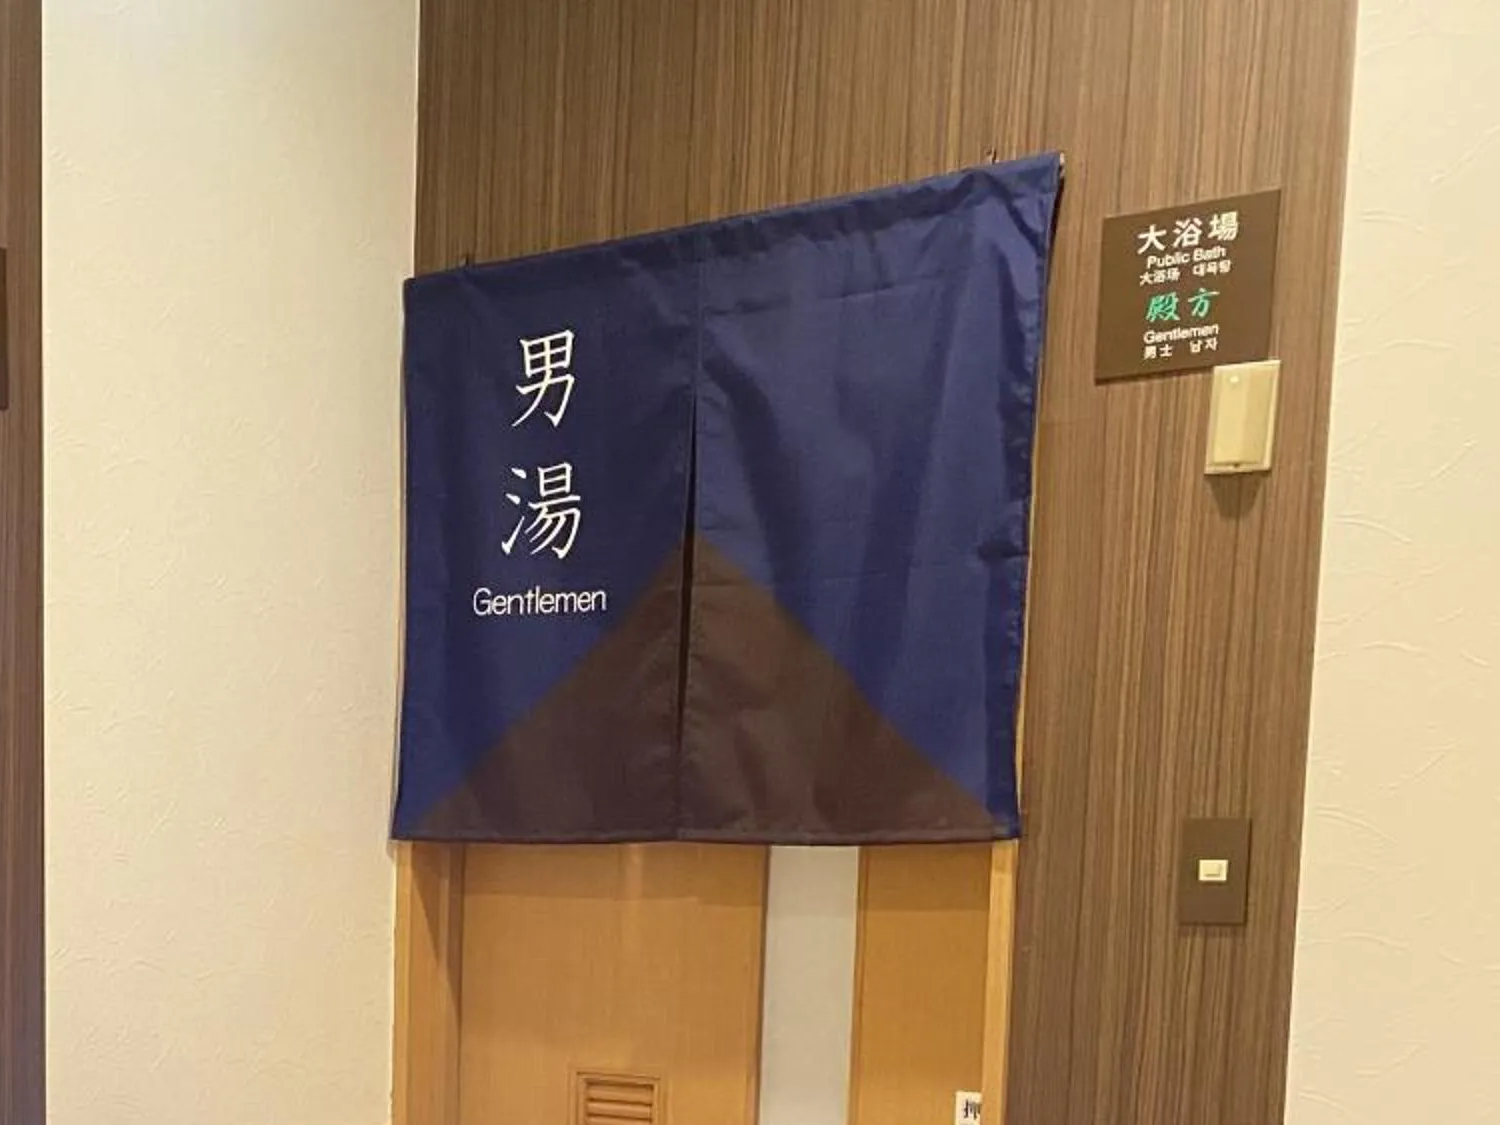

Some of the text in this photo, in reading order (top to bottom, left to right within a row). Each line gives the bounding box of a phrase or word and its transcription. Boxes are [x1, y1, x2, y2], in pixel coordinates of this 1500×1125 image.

[1136, 210, 1239, 255] 大浴場
[1146, 245, 1226, 268] Public Bath
[1145, 287, 1221, 323] 殿方
[1143, 323, 1219, 344] Gentlemen
[501, 329, 581, 560] 男湯
[472, 585, 607, 618] Gentlemen
